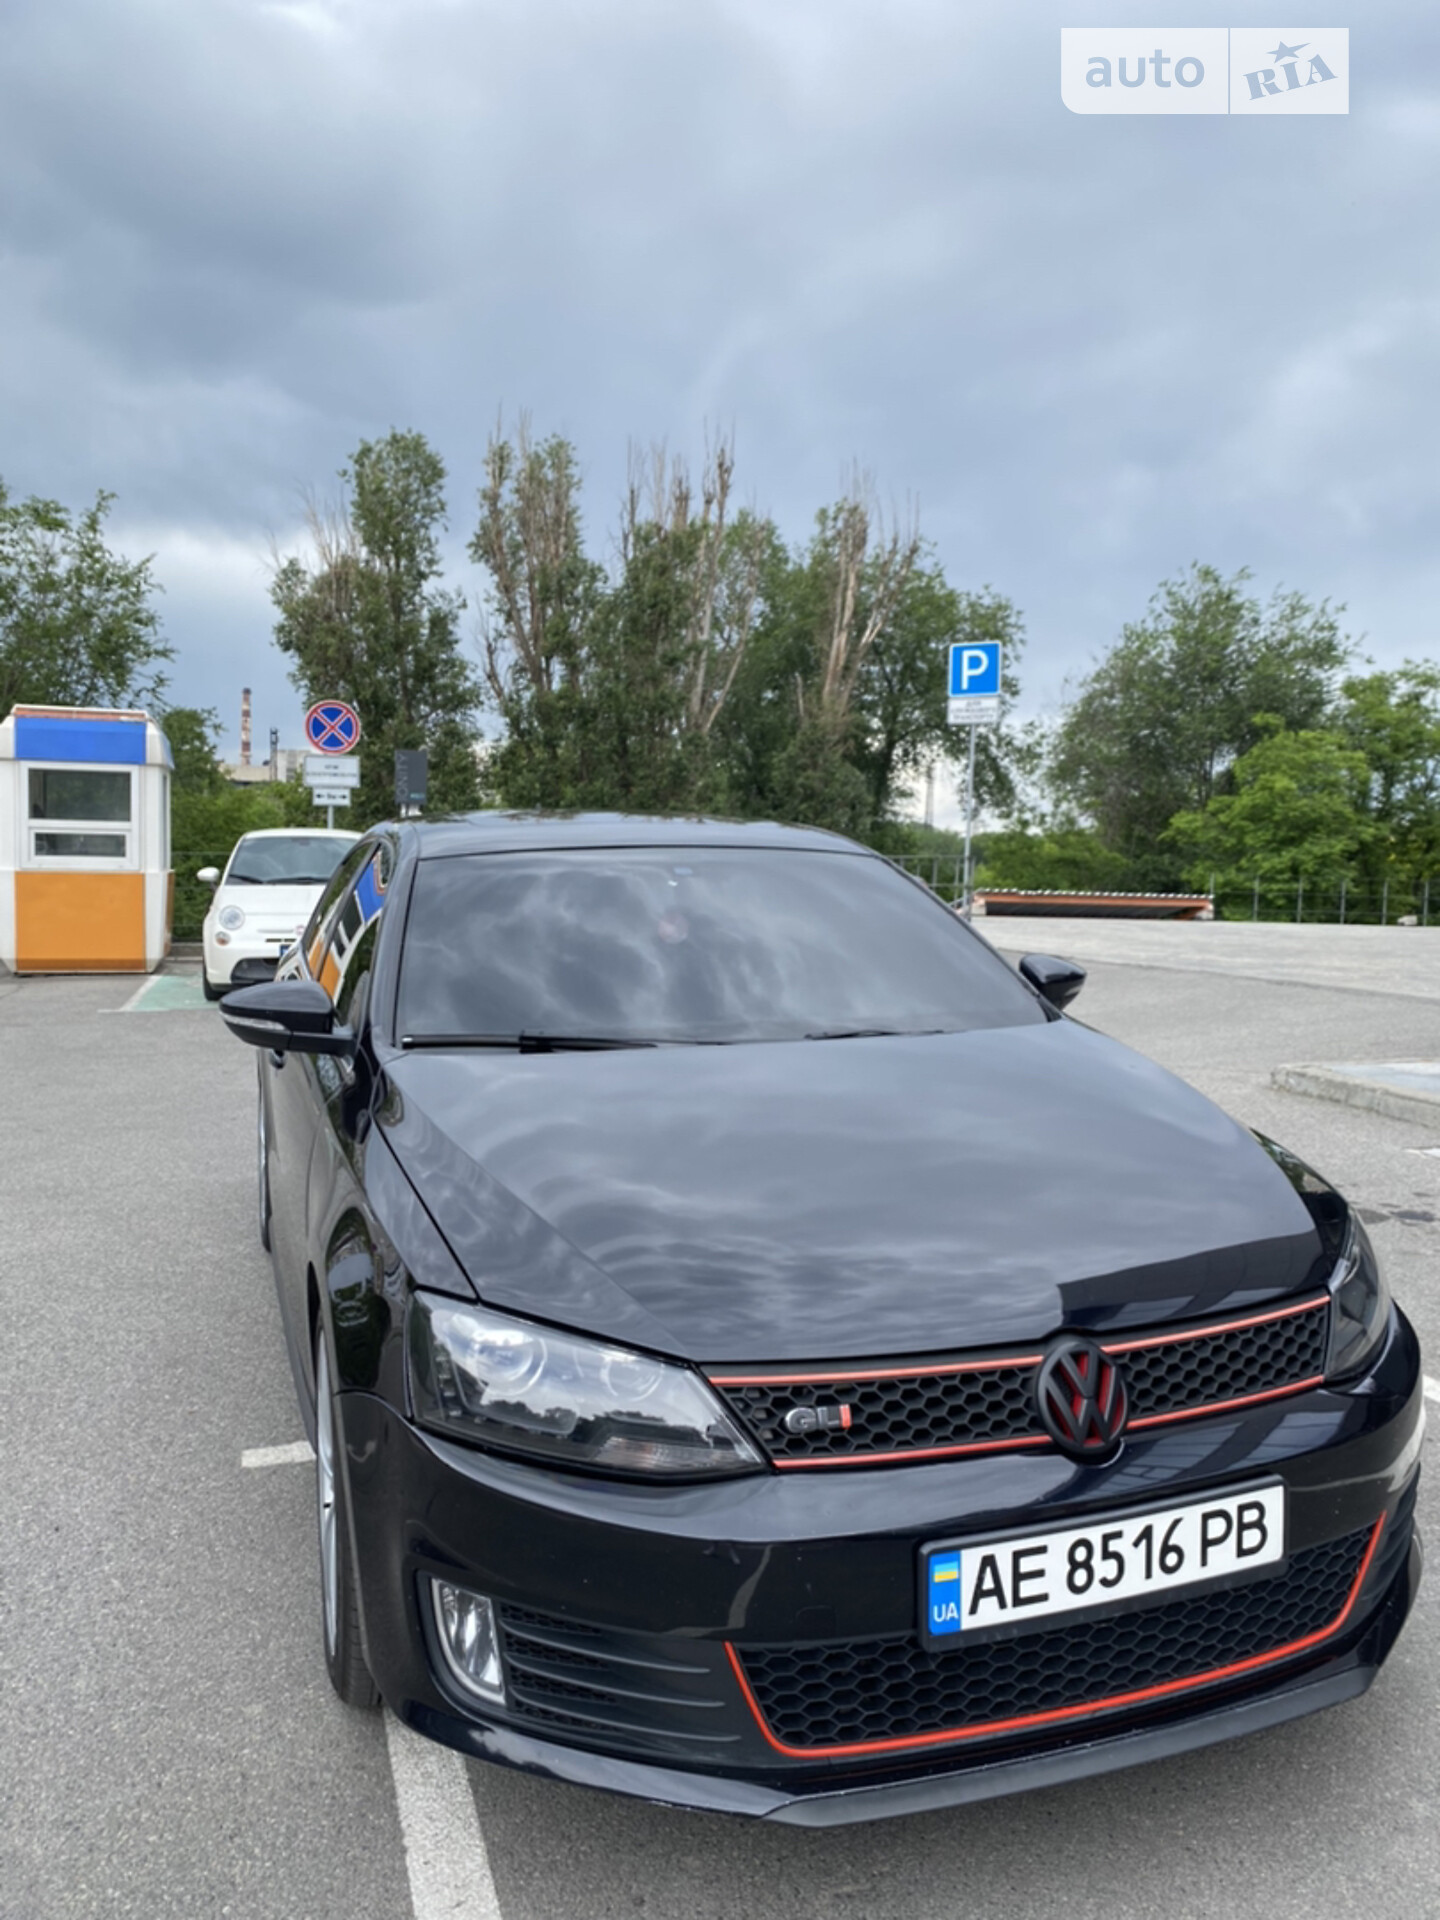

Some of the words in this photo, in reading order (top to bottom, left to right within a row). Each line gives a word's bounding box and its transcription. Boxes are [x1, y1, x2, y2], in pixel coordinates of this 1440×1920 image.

[961, 649, 989, 691] P
[968, 1545, 1050, 1616] AE
[1066, 1517, 1185, 1595] 8516
[1200, 1500, 1269, 1567] PB
[933, 1602, 958, 1622] UA
